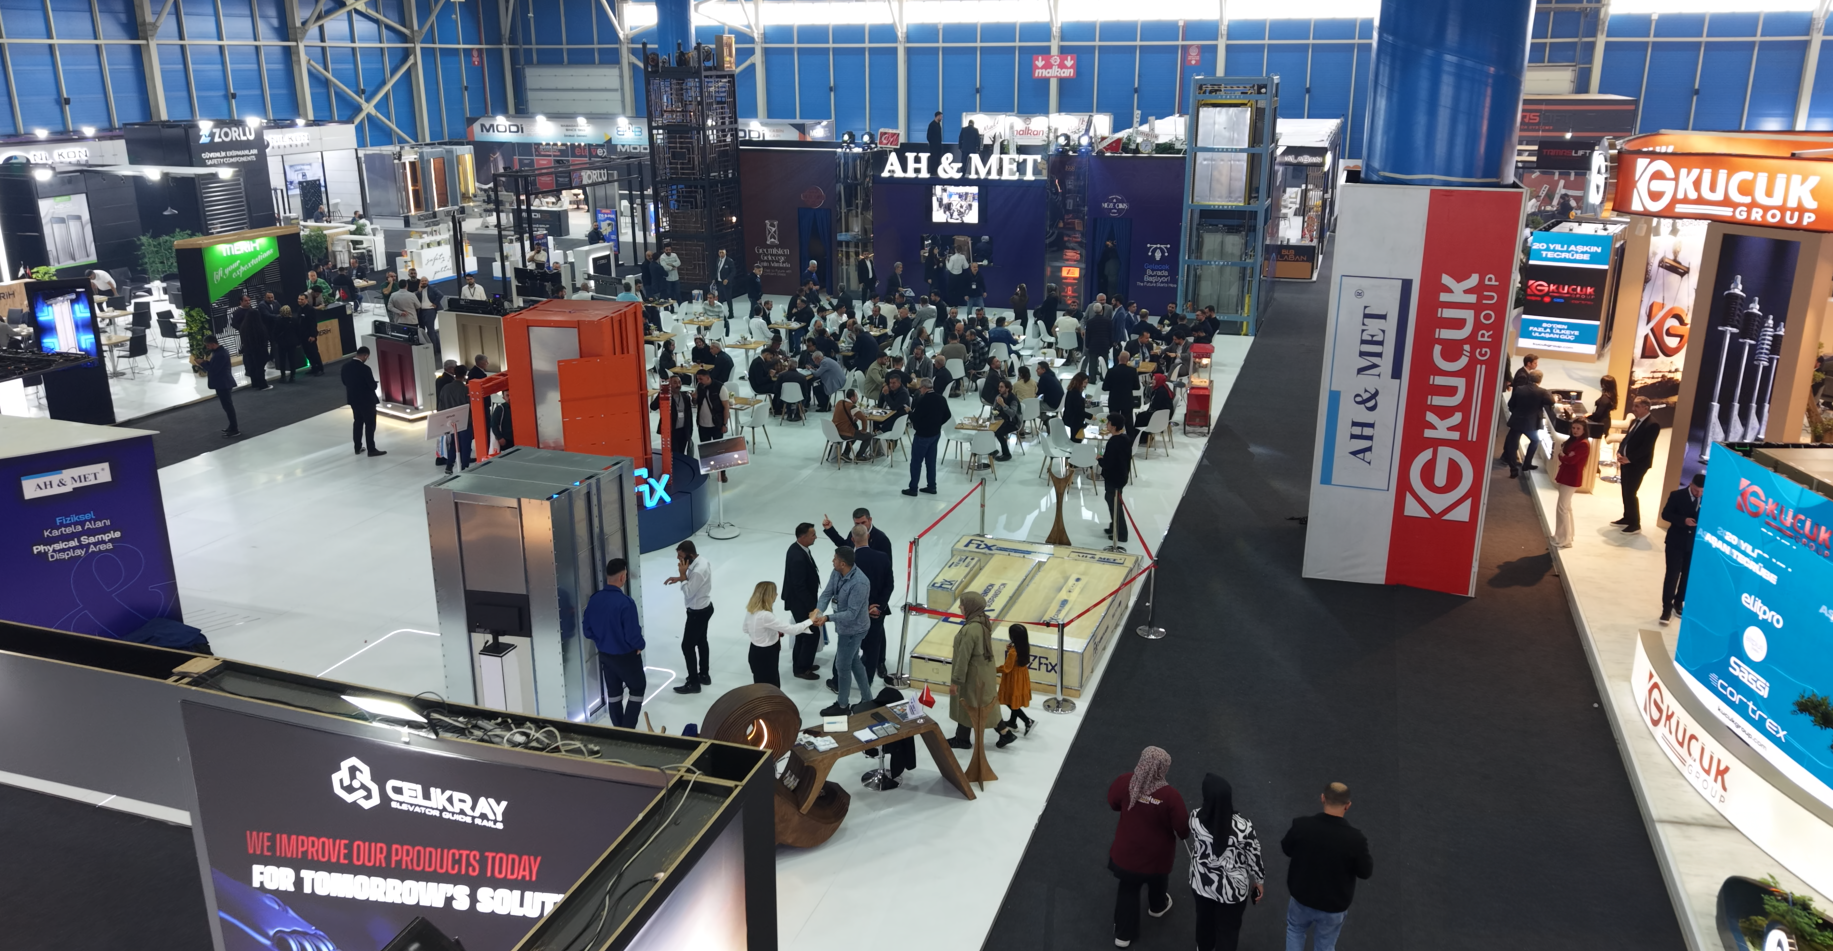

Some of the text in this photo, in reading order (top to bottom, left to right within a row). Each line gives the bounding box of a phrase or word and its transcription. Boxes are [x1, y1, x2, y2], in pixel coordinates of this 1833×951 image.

[1034, 66, 1074, 77] malkan
[213, 121, 256, 143] ZORLU
[617, 144, 650, 153] MOD
[881, 151, 1042, 181] AH & MET
[1735, 206, 1816, 226] GROUP
[1541, 250, 1591, 260] TECRÜBE
[1548, 243, 1567, 251] YILI
[1568, 245, 1602, 253] AŞKIN
[1475, 273, 1500, 360] GROUP
[1423, 273, 1480, 441] KÜÇÜK
[1348, 305, 1389, 466] AH & MET
[34, 471, 100, 492] AH & MET
[43, 519, 111, 538] Kartela Alanı
[55, 511, 96, 526] Fiziksel
[32, 530, 122, 555] Physical Sample
[47, 542, 114, 562] Display Area
[1795, 535, 1830, 558] GROUP
[1741, 592, 1784, 629] elitpro
[1818, 604, 1833, 623] AŞ
[1687, 764, 1726, 804] GROUP
[390, 801, 504, 830] ELEVATOR GUIDE RAILS
[246, 831, 542, 882] WE IMPROVE OUR PRODUCTS TODAY
[252, 864, 565, 919] FOR TOMORROW'S SOLUT
